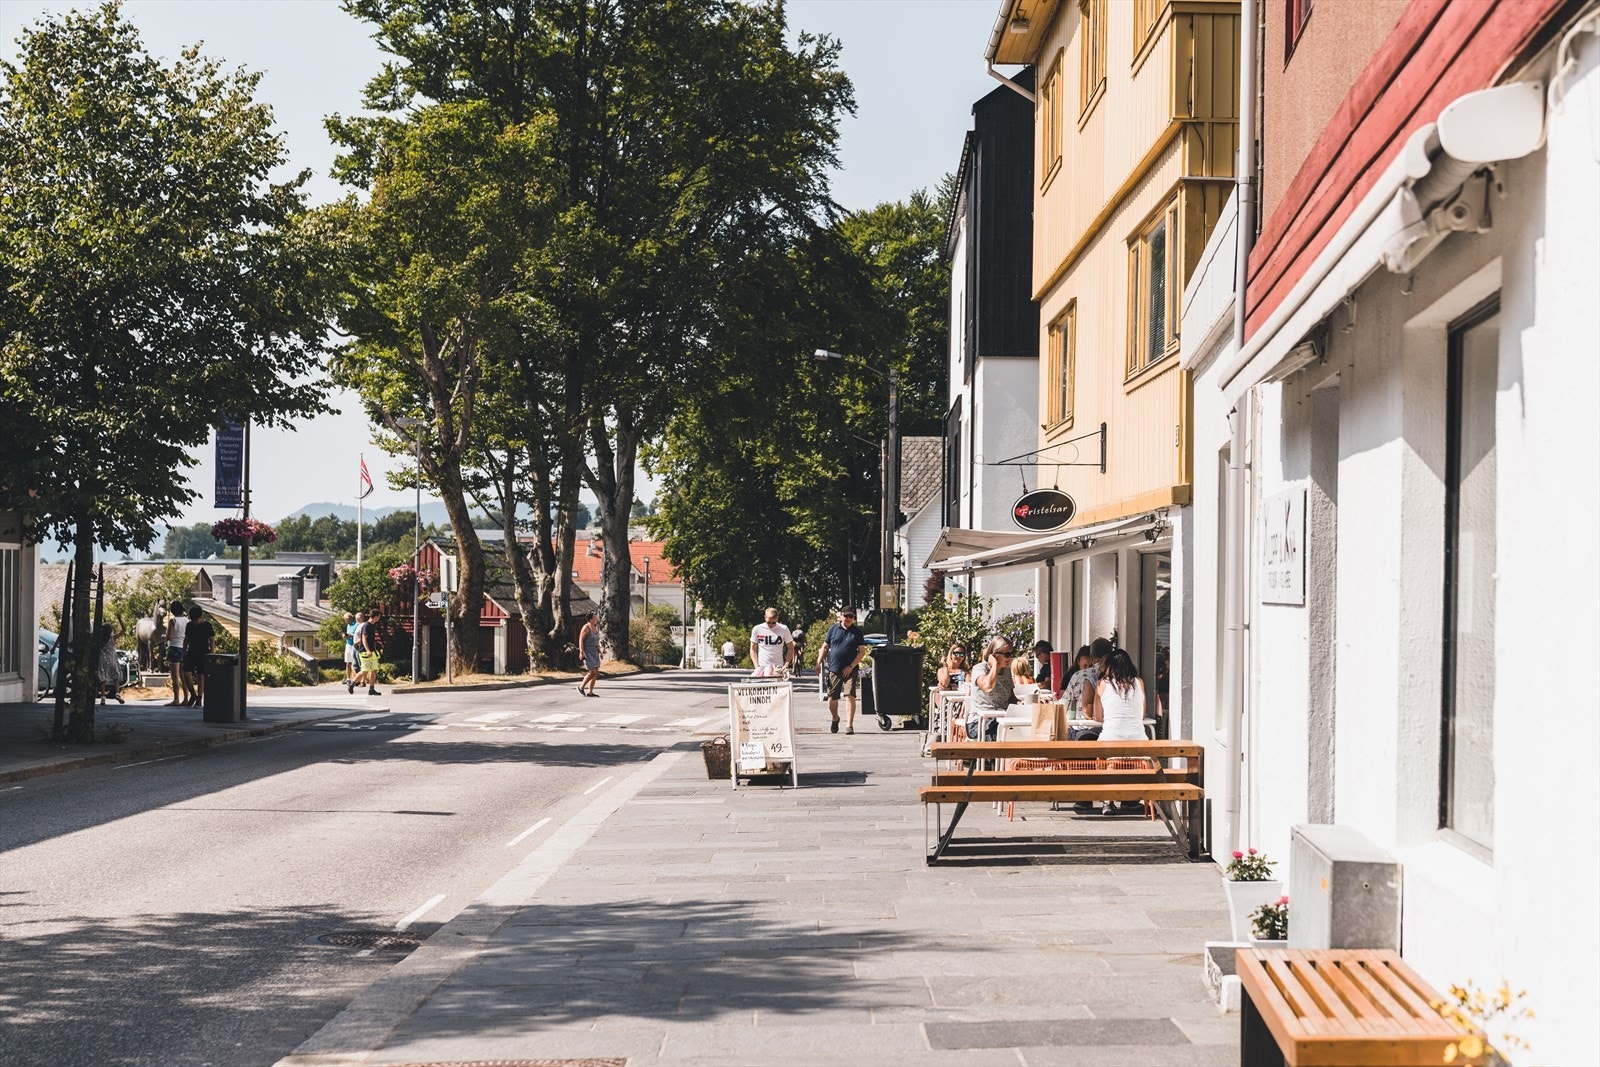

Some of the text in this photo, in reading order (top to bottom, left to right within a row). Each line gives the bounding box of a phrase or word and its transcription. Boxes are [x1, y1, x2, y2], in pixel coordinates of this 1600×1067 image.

[1019, 504, 1068, 517] Fristelsar
[757, 635, 782, 645] FILA
[737, 686, 778, 696] VELKOMMEN
[749, 696, 771, 704] INNOM
